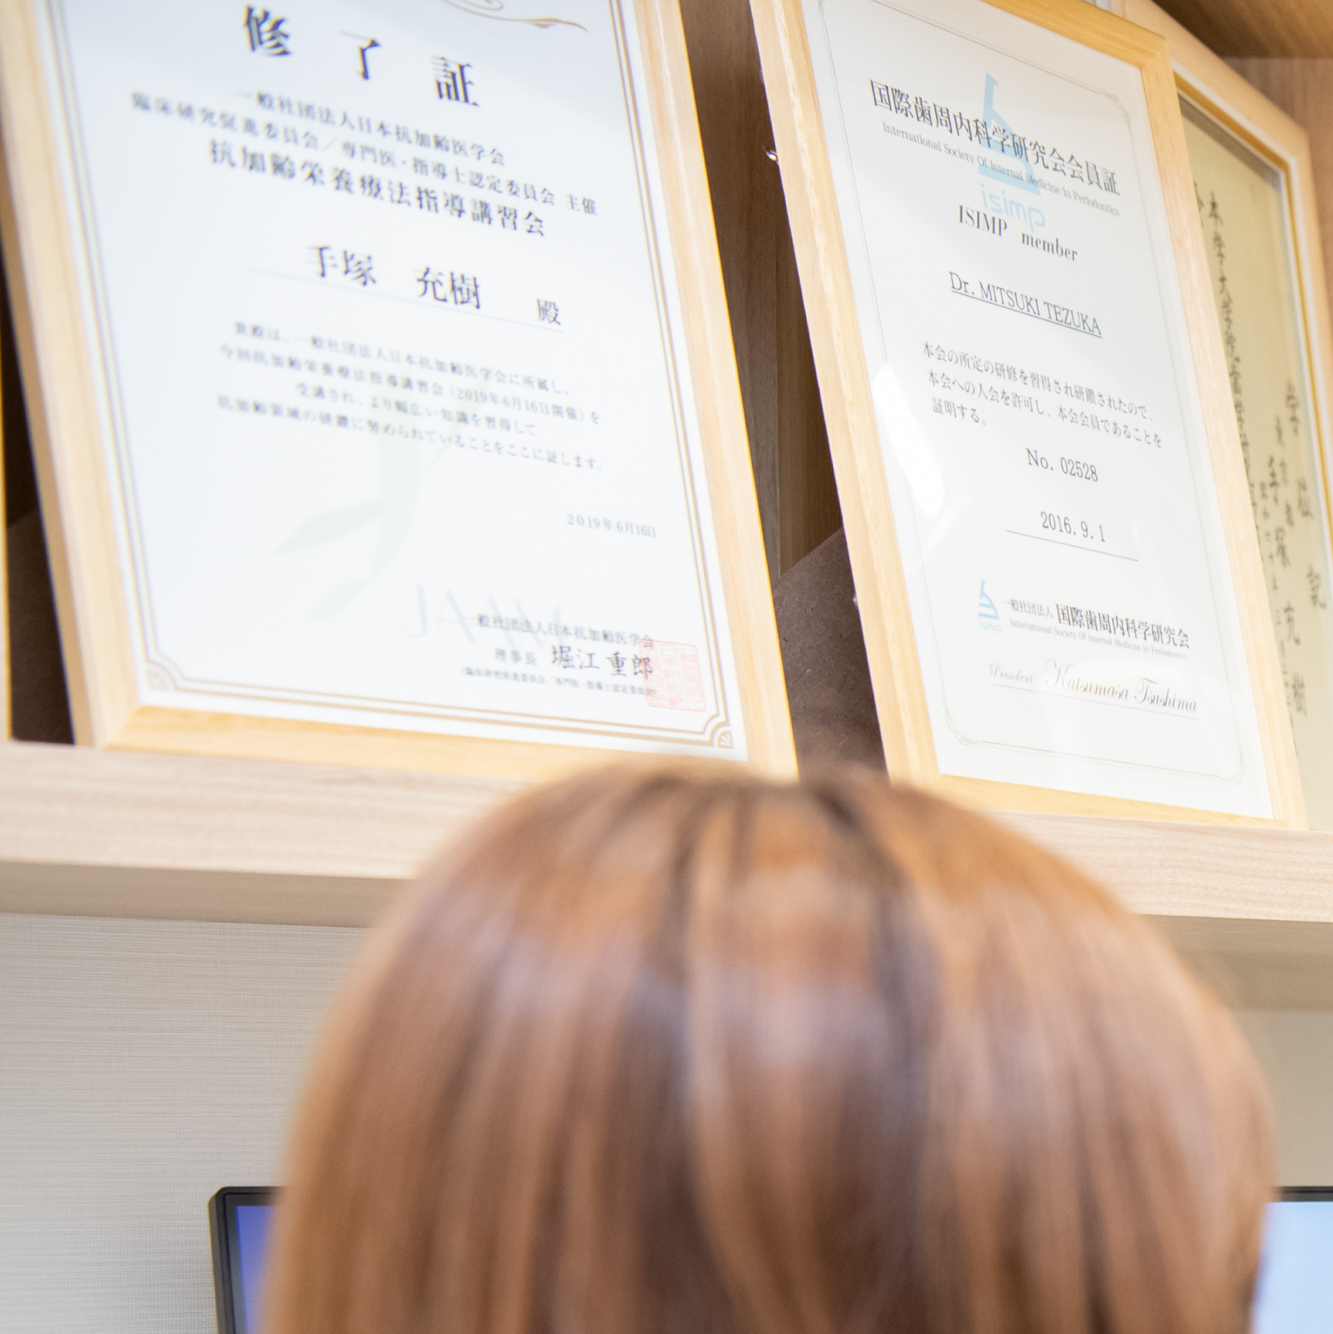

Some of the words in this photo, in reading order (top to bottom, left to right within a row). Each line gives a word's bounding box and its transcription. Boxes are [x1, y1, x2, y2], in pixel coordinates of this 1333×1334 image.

[242, 4, 480, 107] 修了証
[869, 78, 1120, 196] 国際歯周内科学研究会会員証
[882, 121, 941, 152] International
[943, 143, 974, 164] Society
[977, 155, 988, 169] Of
[990, 159, 1024, 181] Internal
[1025, 171, 1060, 195] Medicine
[1062, 186, 1072, 198] In
[1073, 191, 1120, 217] Periodontics
[959, 204, 1007, 237] ISIMP
[1021, 230, 1078, 262] member
[979, 183, 1046, 233] isimp
[311, 245, 377, 286] 手塚
[416, 266, 482, 310] 充樹
[536, 297, 563, 326] 殿
[947, 270, 976, 297] Dr.
[979, 282, 1041, 319] MITSUKI
[1043, 301, 1102, 336] TEZUKA
[931, 397, 987, 426] 証明する。
[1026, 447, 1054, 471] No.
[1060, 457, 1098, 483] 02528
[1009, 618, 1051, 634] International
[1053, 627, 1077, 640] Society
[1055, 603, 1190, 649] 国際歯周内科学研究会
